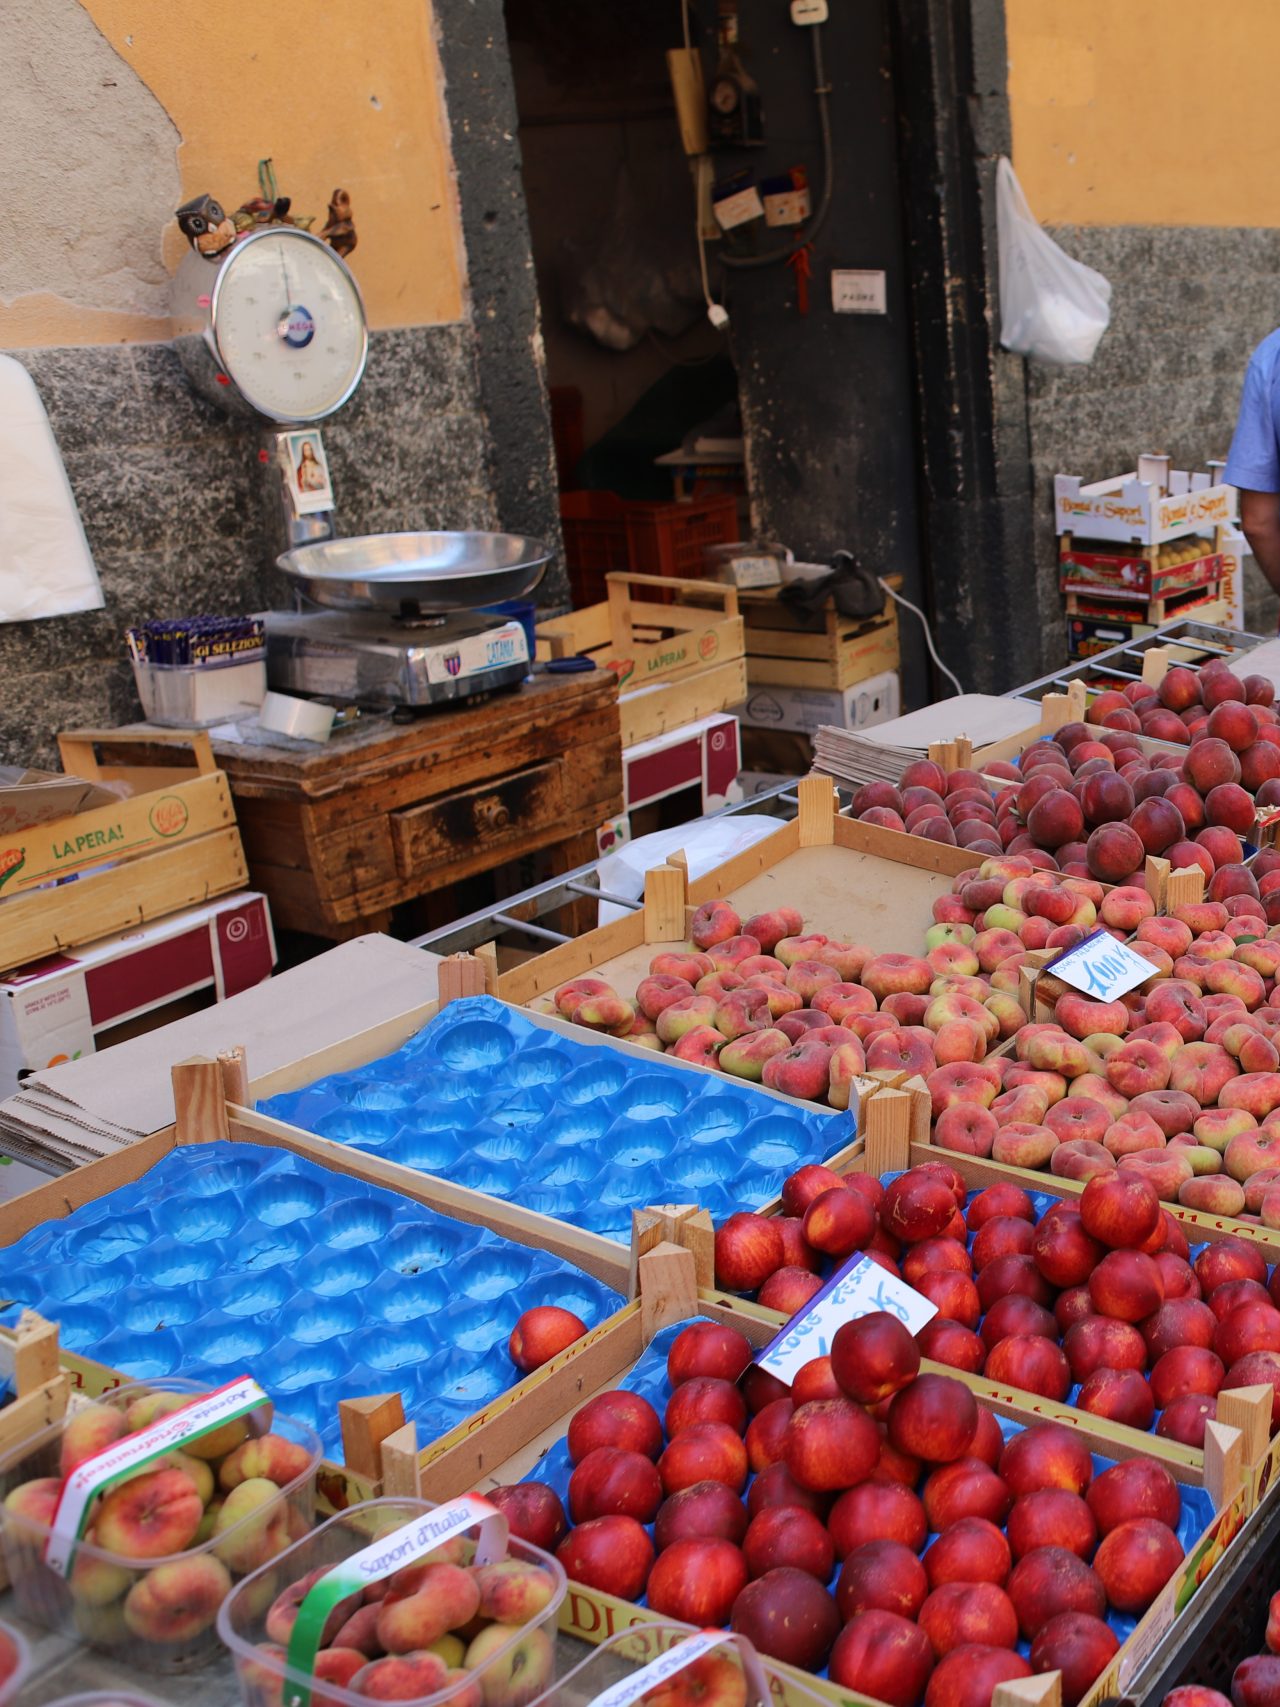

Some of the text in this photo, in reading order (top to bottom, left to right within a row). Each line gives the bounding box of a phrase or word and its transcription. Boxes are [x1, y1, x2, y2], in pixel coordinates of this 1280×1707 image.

[52, 825, 124, 859] LA PERA!
[360, 1508, 472, 1577] Sapori d'Italia
[569, 1593, 616, 1639] DI
